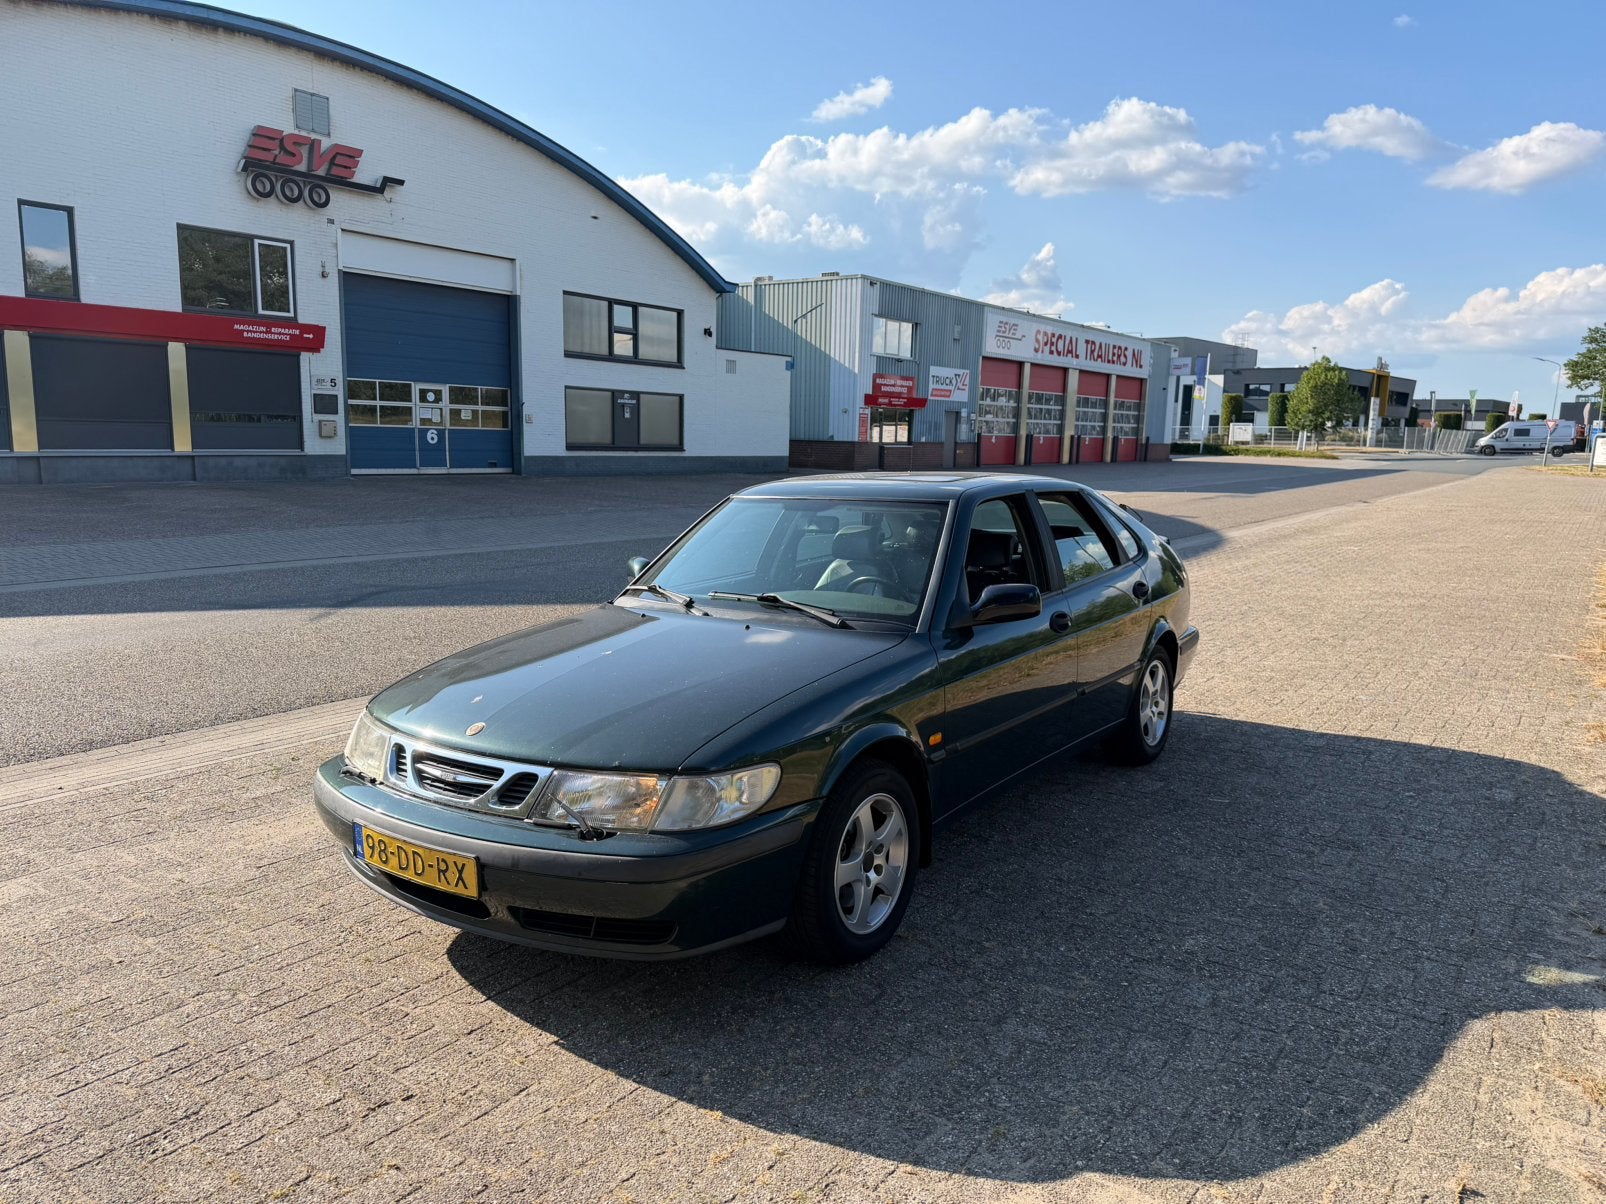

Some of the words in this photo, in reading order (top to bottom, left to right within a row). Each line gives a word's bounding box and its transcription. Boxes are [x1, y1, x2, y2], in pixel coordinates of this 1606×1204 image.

[245, 125, 364, 179] ESVE
[271, 327, 300, 335] REPARATIE
[996, 320, 1019, 336] ESVE
[243, 332, 290, 341] BANDENSERVICE
[1033, 329, 1079, 359] SPECIAL
[1084, 339, 1128, 369] TRAILERS
[1131, 348, 1143, 369] NL
[330, 378, 337, 388] 5
[931, 375, 954, 387] TRUCK
[426, 429, 438, 444] 6
[365, 833, 468, 889] 98-DD-RX
